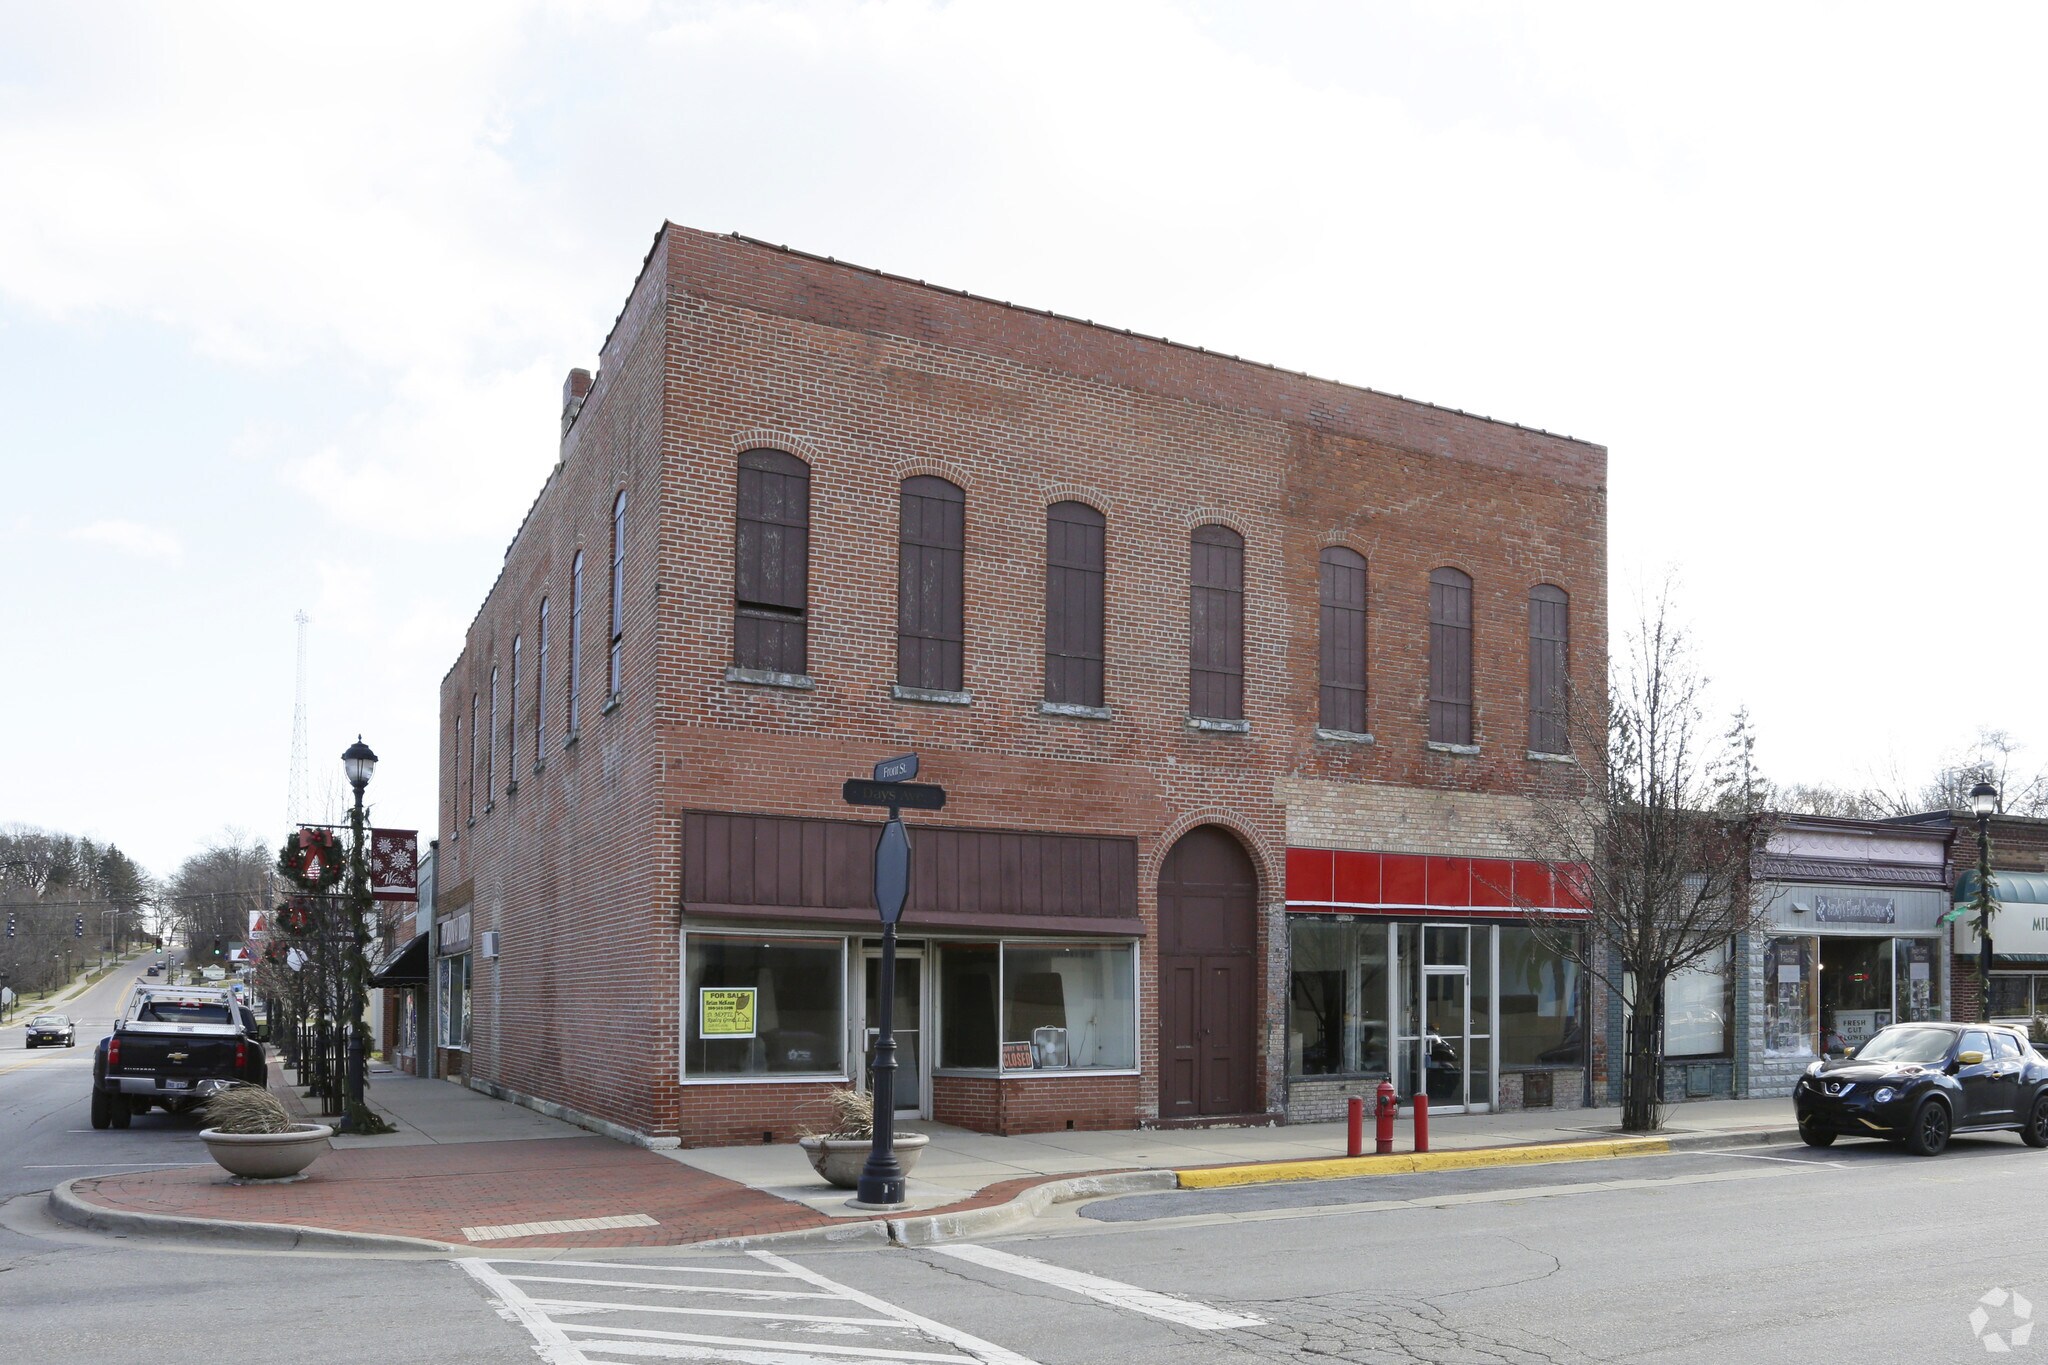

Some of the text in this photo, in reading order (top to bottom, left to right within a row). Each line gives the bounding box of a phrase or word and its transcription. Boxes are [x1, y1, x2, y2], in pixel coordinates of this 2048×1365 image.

[883, 766, 899, 778] Front
[863, 787, 896, 803] Days
[380, 870, 406, 885] Winter
[1003, 1053, 1031, 1067] CLOSED
